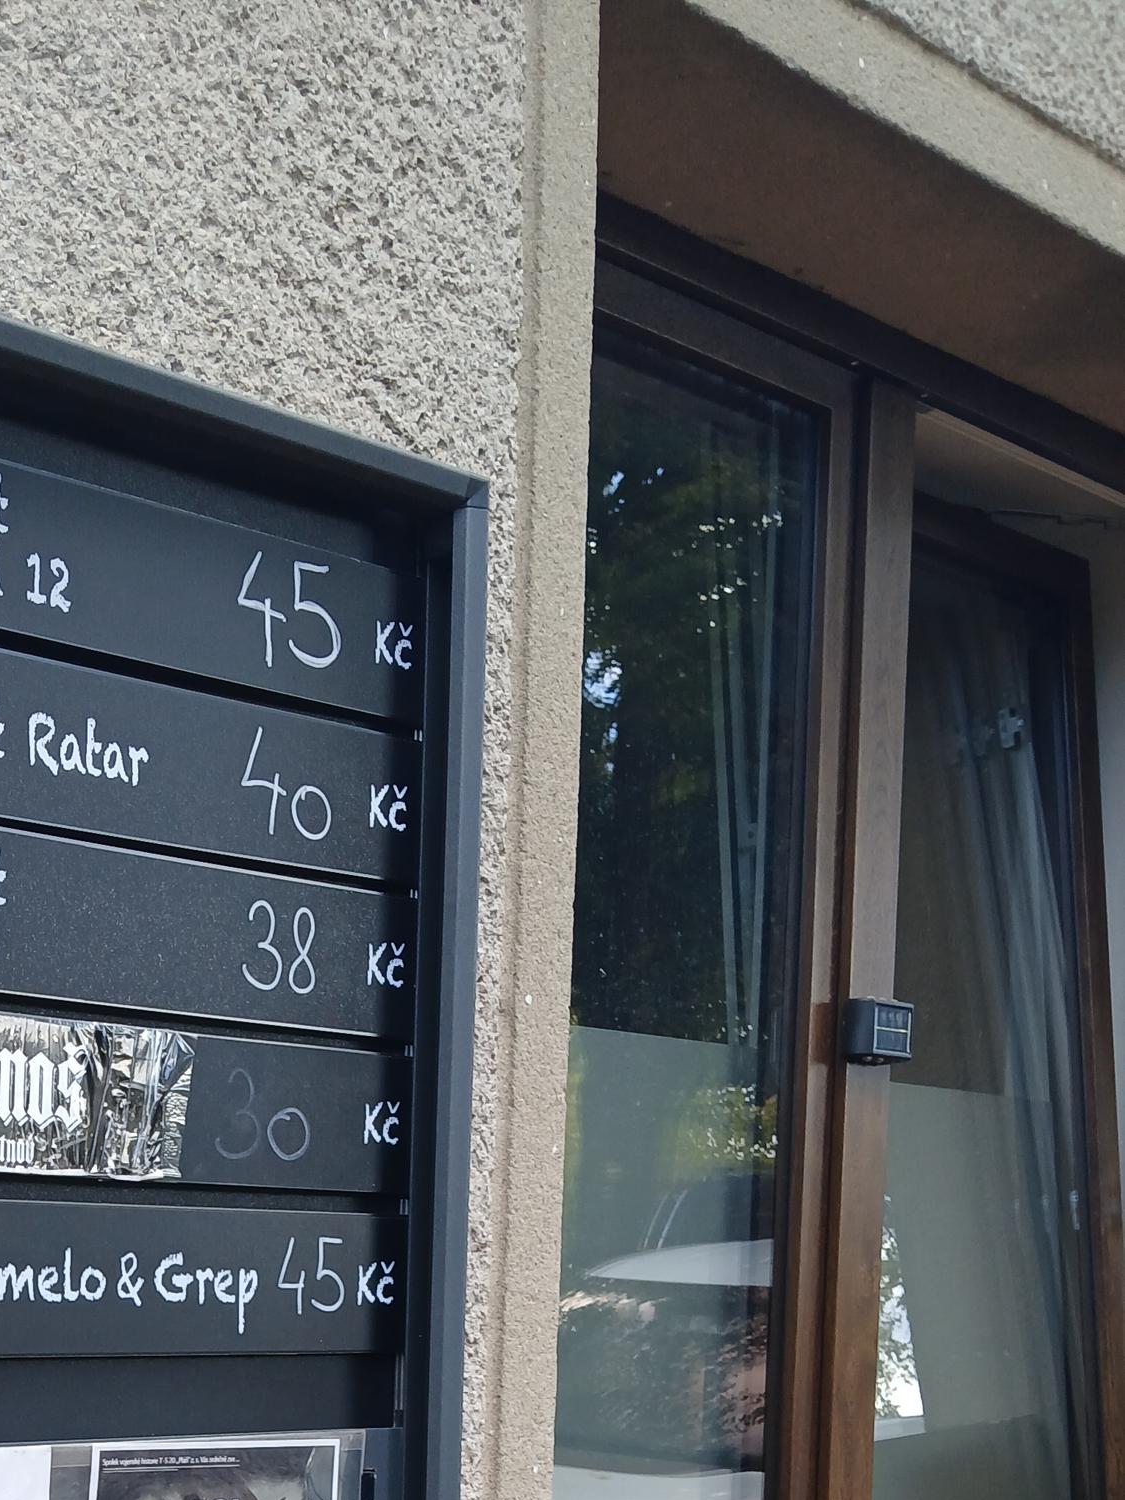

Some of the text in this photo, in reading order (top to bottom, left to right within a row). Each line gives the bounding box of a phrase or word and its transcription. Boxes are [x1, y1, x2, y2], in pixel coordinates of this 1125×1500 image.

[27, 553, 71, 613] 12
[238, 551, 413, 670] 45 Kč
[28, 712, 149, 786] Ratar
[241, 727, 408, 840] 40 Kč
[242, 900, 405, 994] 38 Kč
[215, 1068, 400, 1161] 30 Kč
[154, 1252, 259, 1334] Grep
[278, 1236, 395, 1315] 45 Kč
